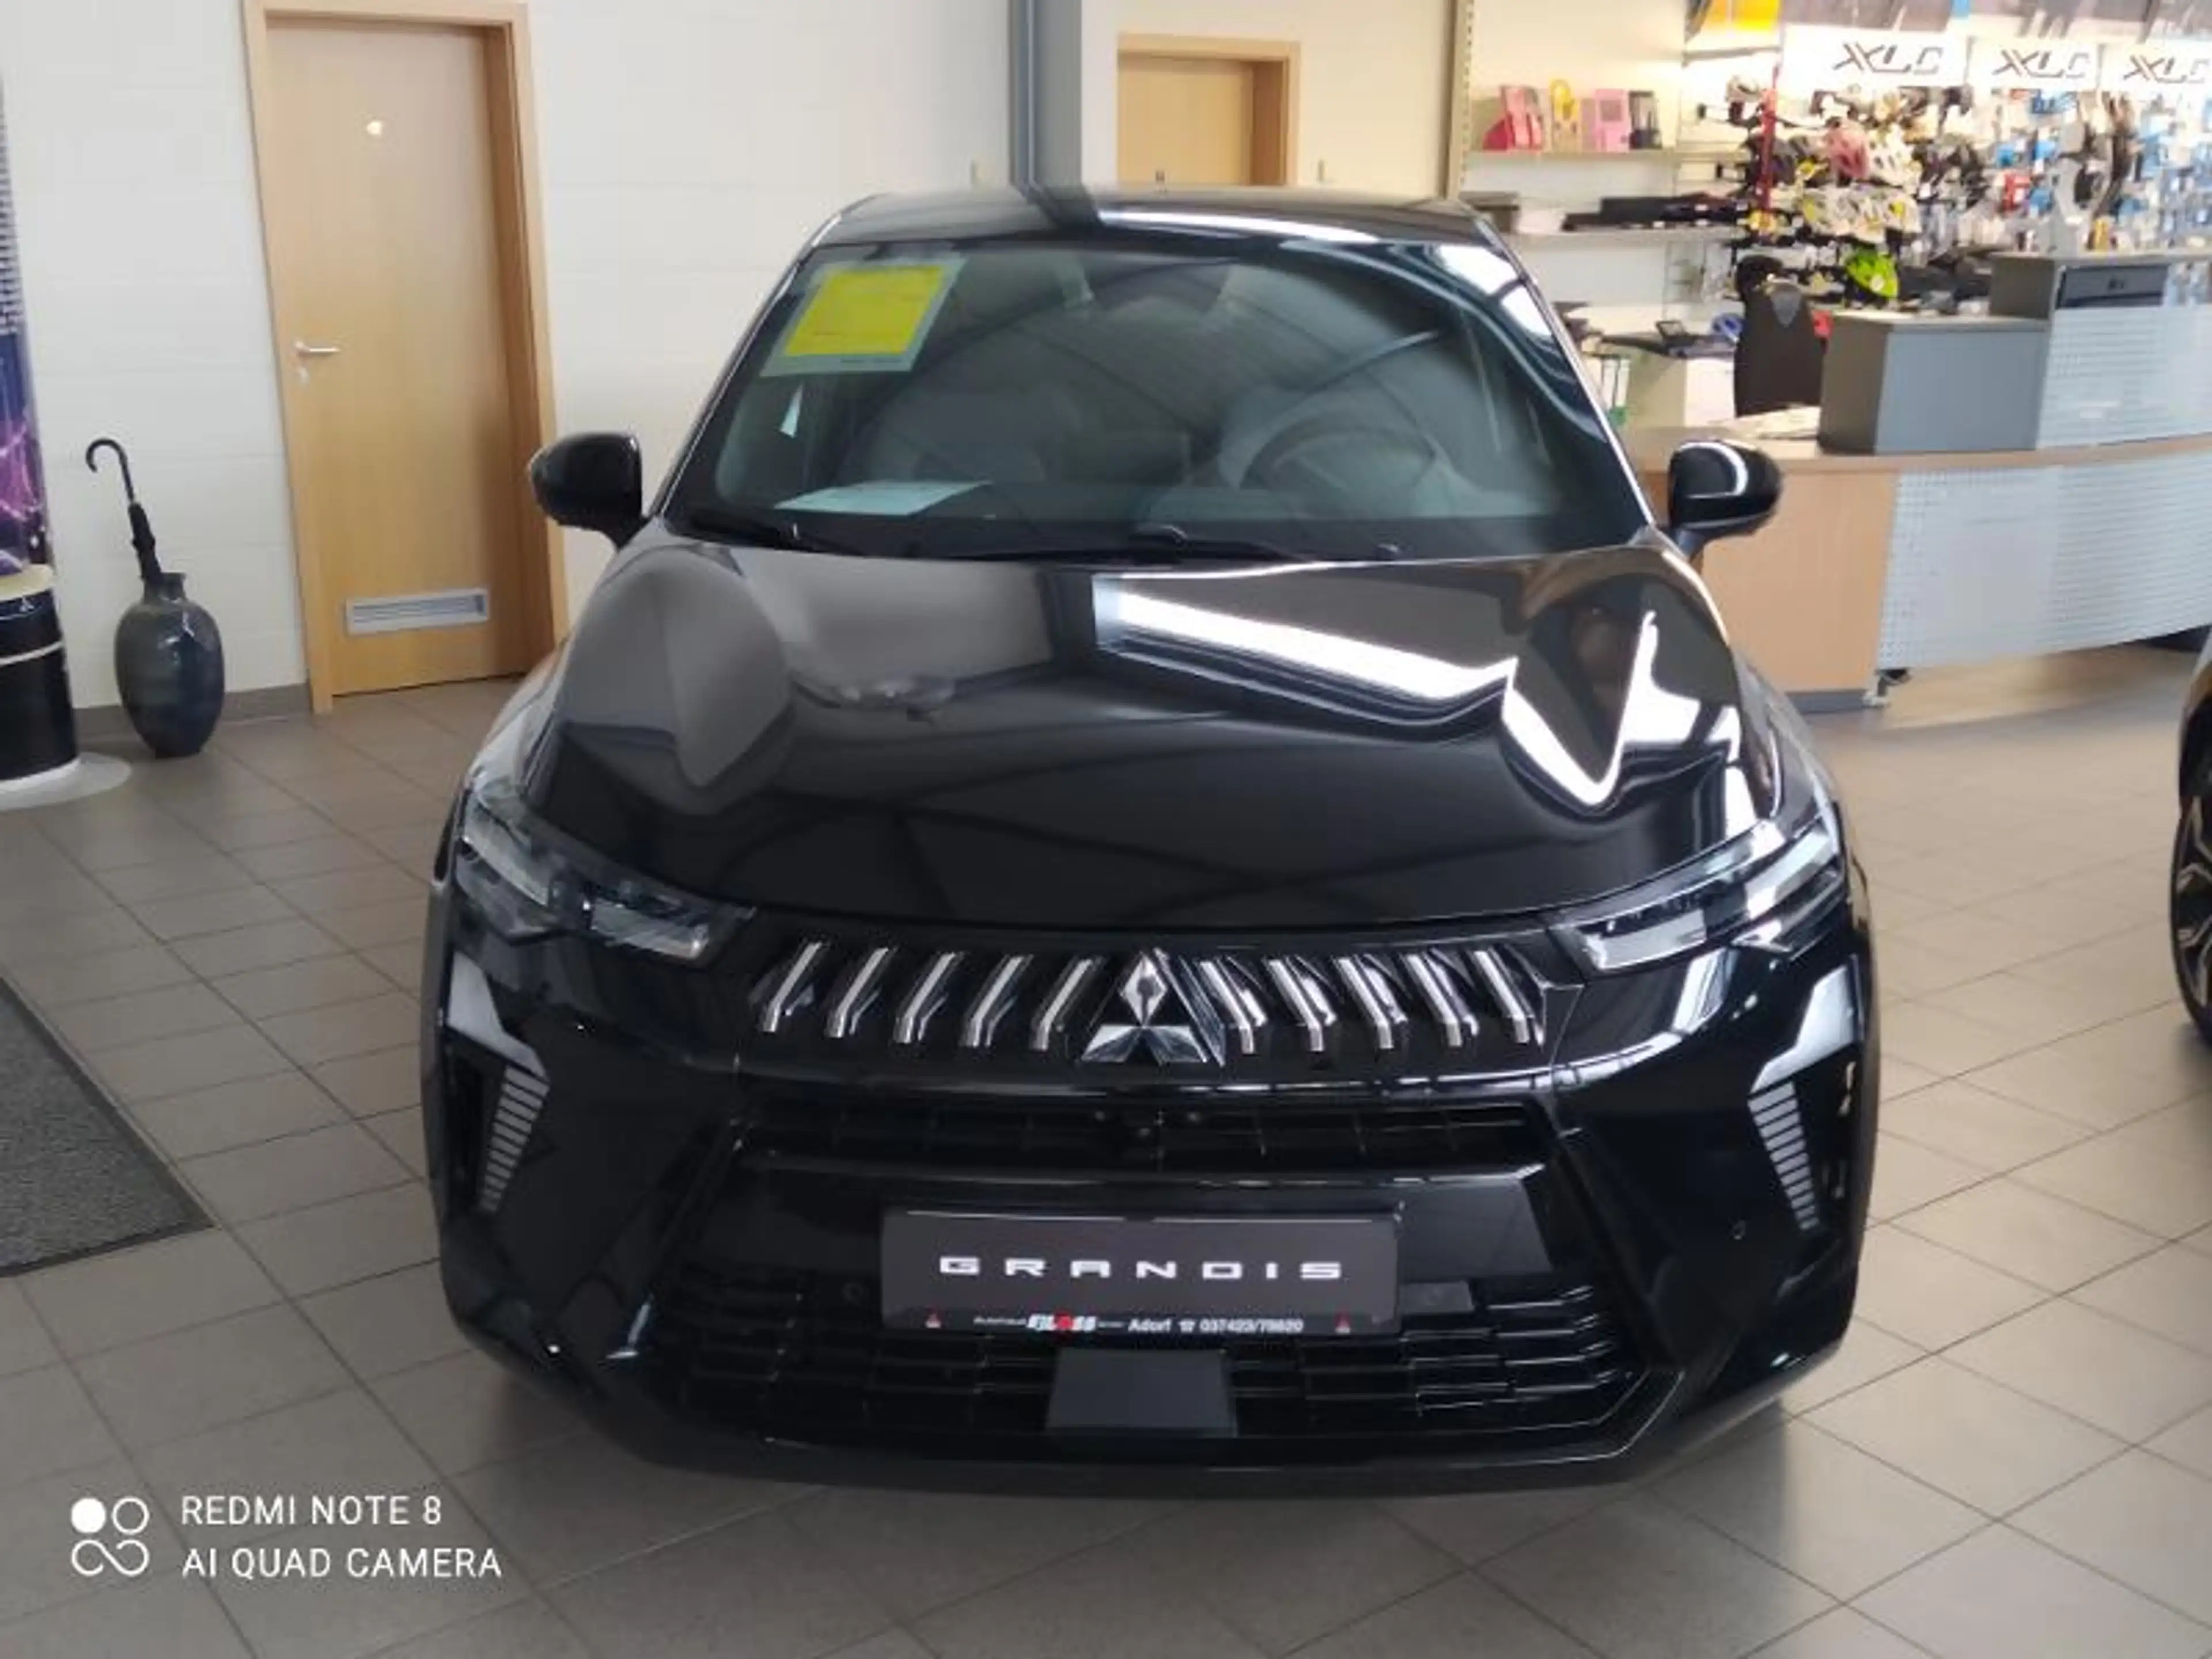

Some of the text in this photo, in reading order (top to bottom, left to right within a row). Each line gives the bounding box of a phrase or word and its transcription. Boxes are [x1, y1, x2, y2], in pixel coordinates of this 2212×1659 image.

[1831, 42, 1944, 75] XLC
[1991, 50, 2090, 79] XLC
[940, 1256, 1342, 1279] GRANDIS
